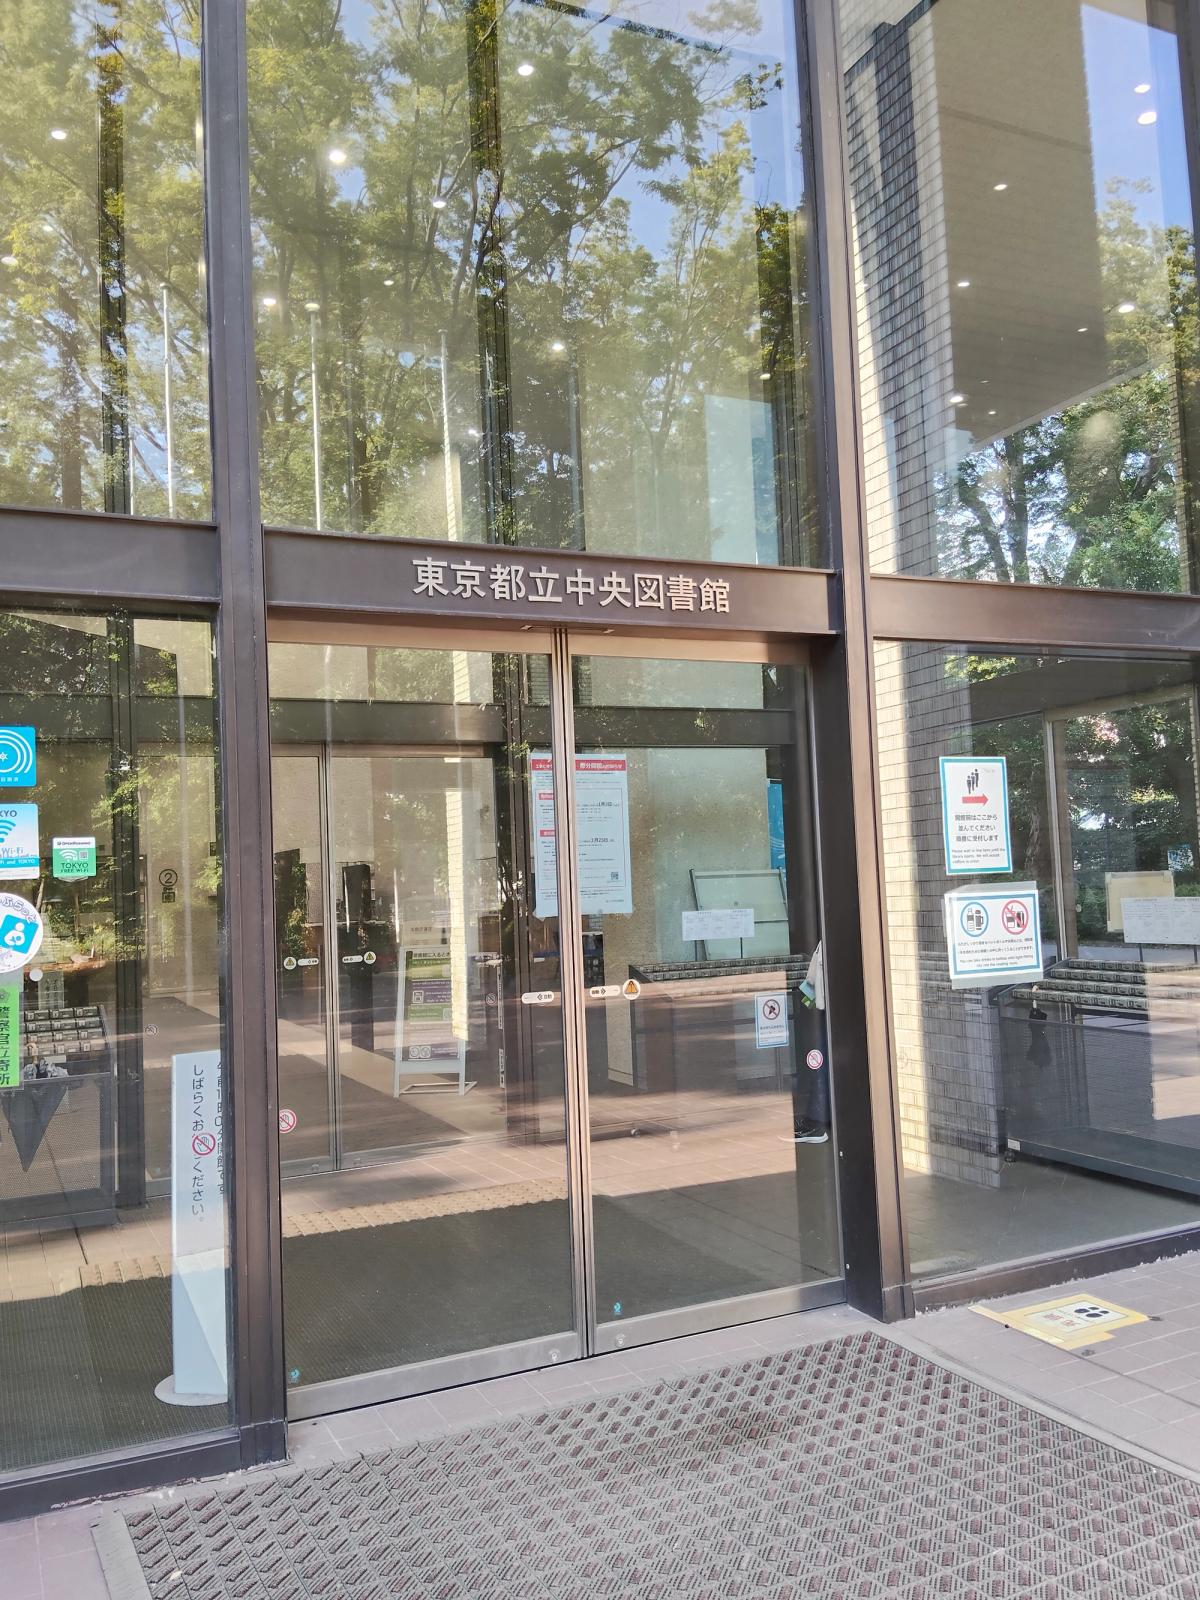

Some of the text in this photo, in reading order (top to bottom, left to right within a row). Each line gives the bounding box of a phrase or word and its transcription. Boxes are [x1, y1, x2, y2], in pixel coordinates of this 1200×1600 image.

[412, 557, 730, 613] 東京都立中央図書館
